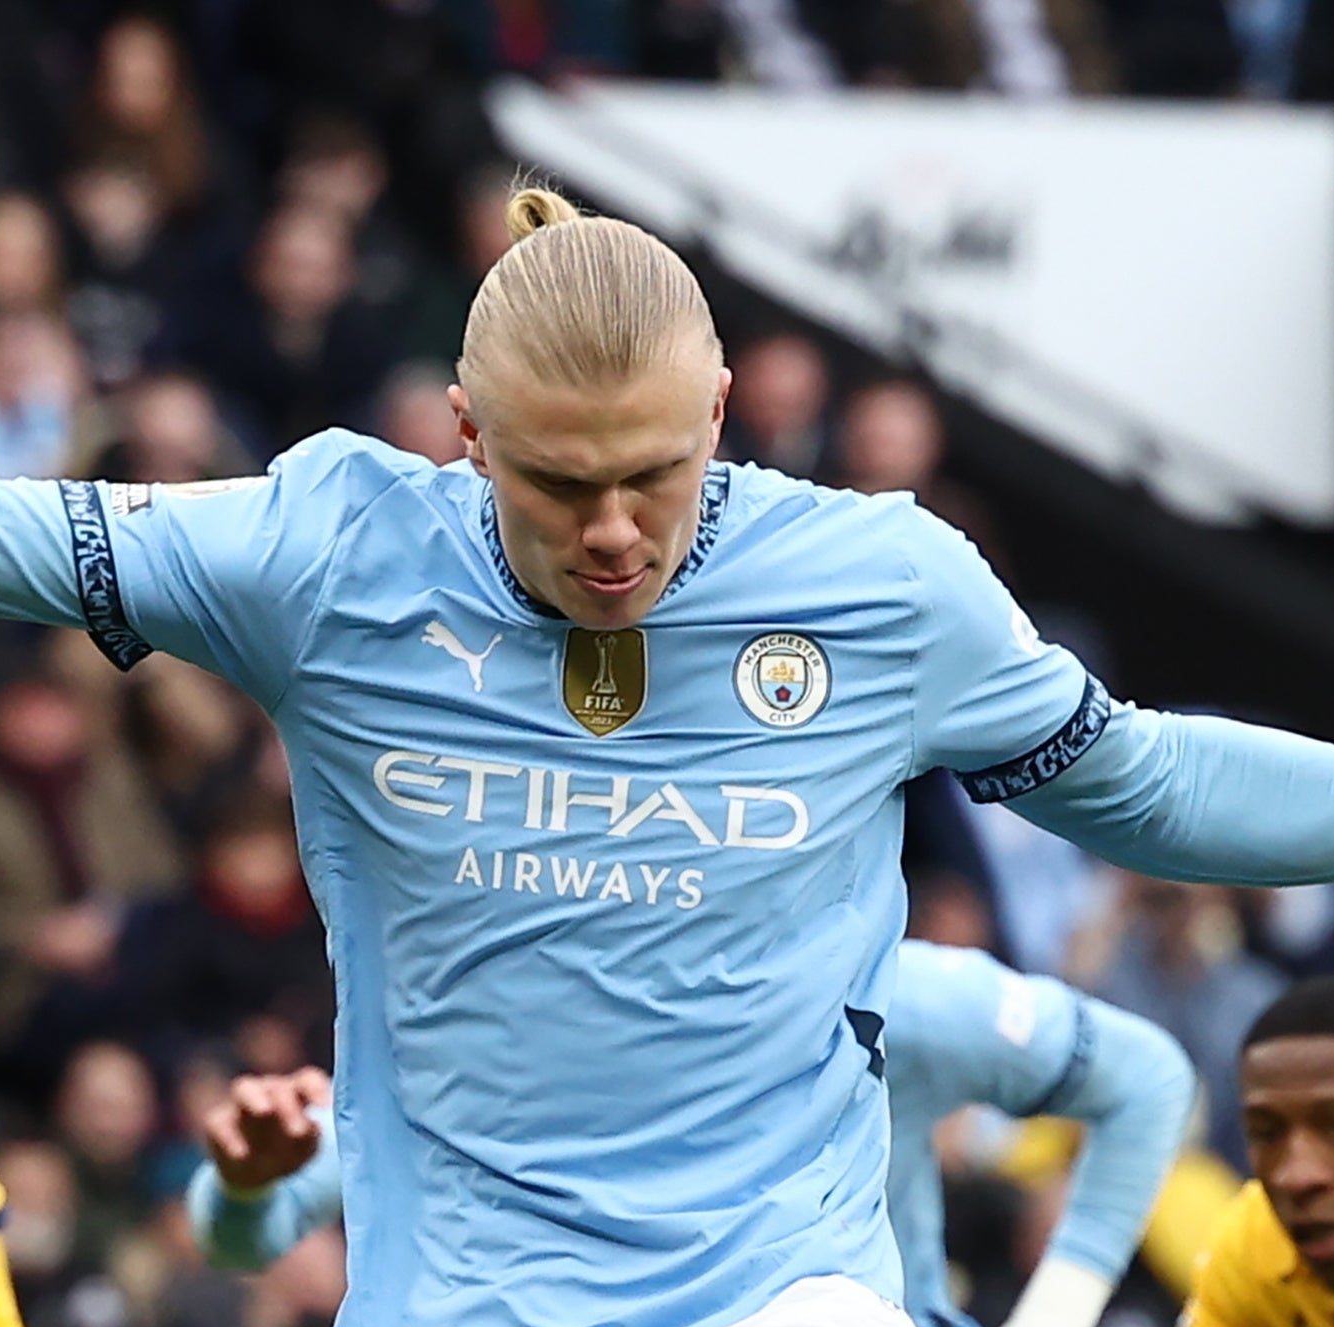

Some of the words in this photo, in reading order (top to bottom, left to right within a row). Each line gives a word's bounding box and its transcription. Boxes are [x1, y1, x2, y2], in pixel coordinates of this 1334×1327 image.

[744, 636, 821, 668] MANCHESTER
[584, 695, 622, 711] FIFA
[769, 712, 796, 723] CITY
[373, 750, 811, 850] ETIHAD
[454, 846, 707, 910] AIRWAYS
